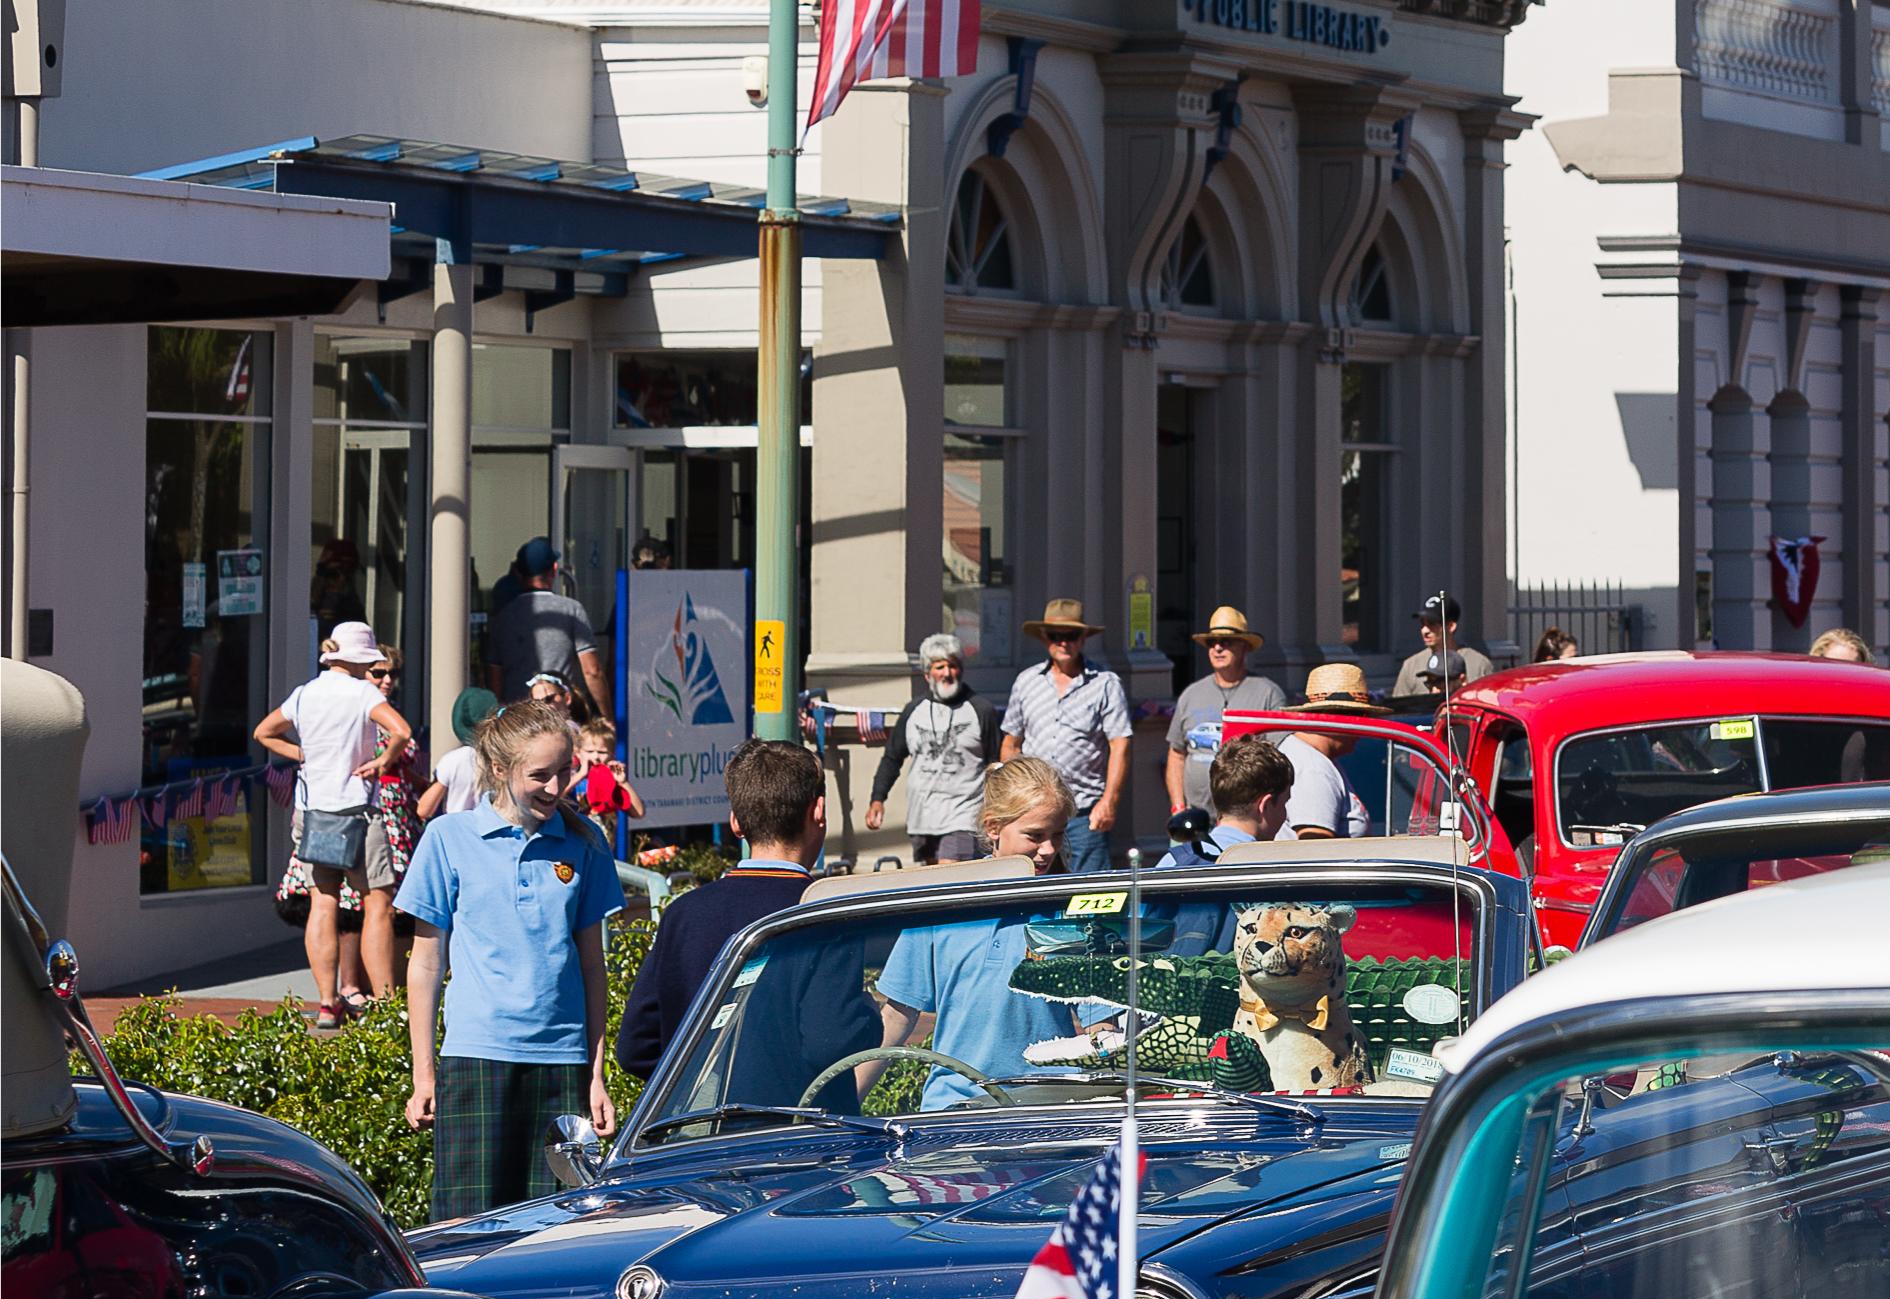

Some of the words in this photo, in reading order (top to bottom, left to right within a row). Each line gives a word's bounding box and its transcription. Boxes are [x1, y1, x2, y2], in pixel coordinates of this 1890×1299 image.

[1287, 1, 1381, 54] LIBRARY
[757, 667, 781, 676] ROSS
[1726, 726, 1748, 736] 598
[1078, 898, 1116, 911] 712
